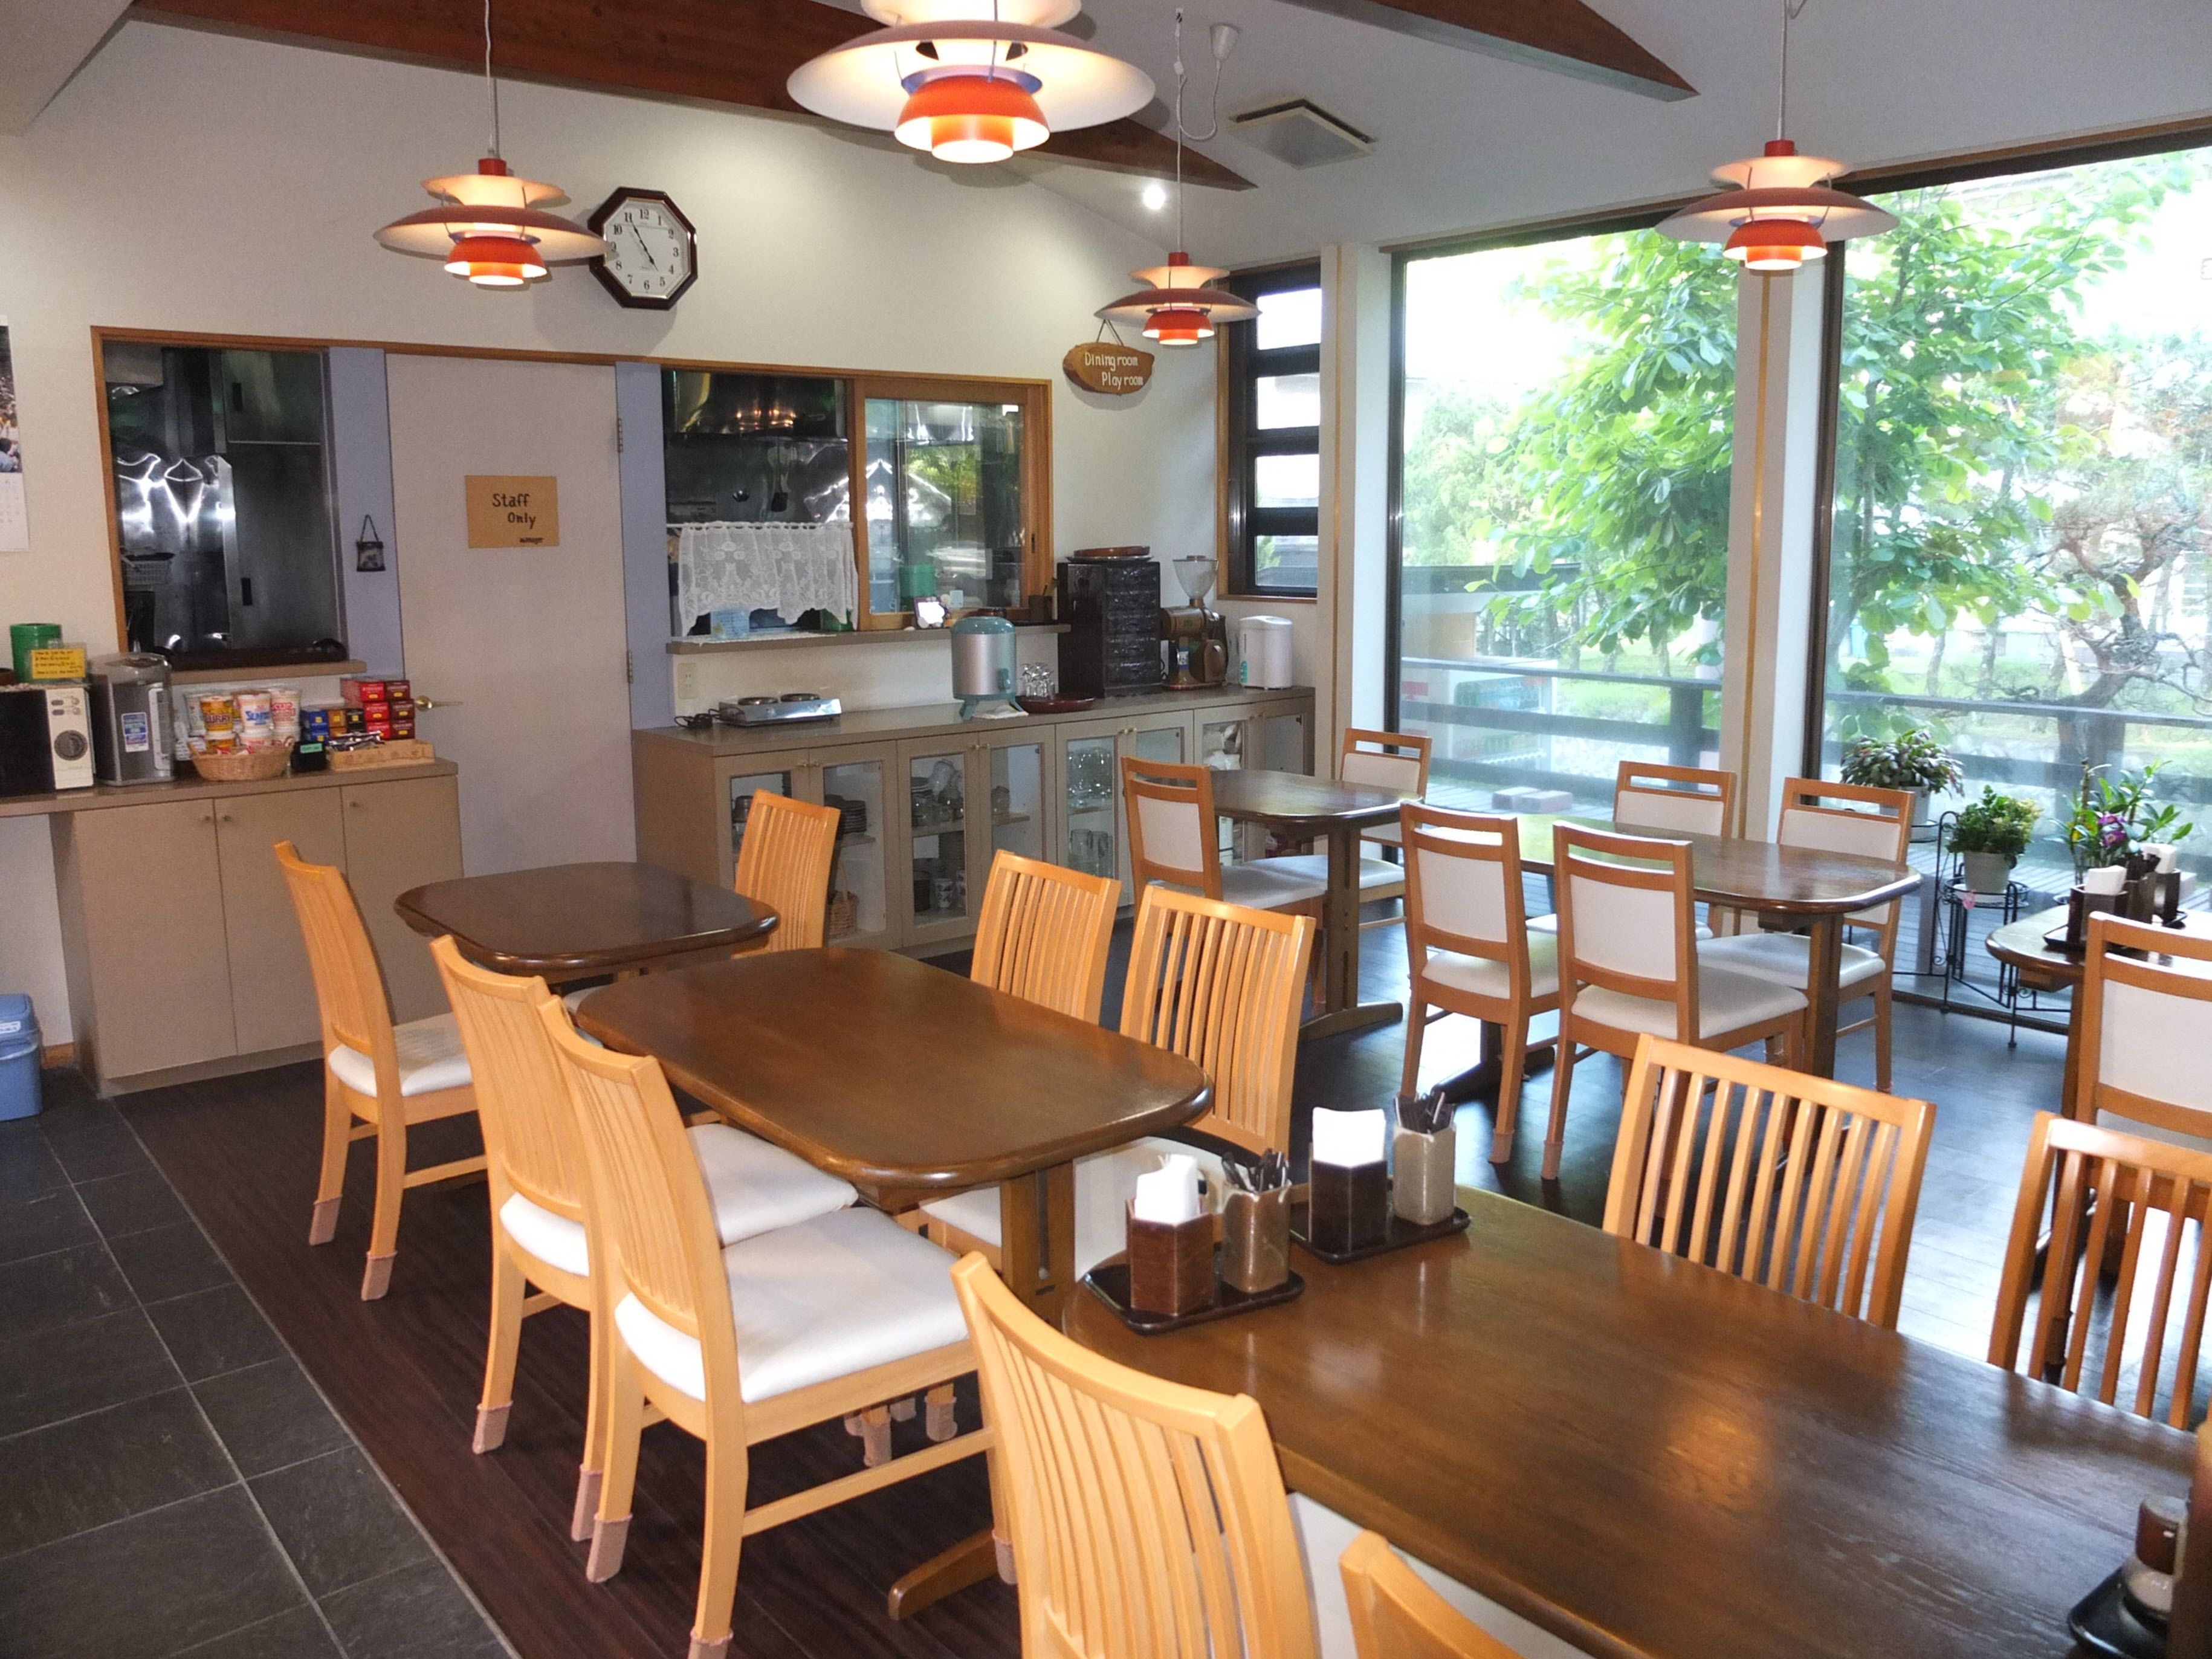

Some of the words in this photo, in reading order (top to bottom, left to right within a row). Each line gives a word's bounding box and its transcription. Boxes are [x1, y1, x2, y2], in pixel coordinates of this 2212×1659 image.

[624, 212, 633, 222] 11
[639, 209, 650, 220] 12
[658, 216, 662, 225] 1
[613, 224, 623, 234] 10
[668, 229, 674, 239] 2
[610, 242, 617, 252] 9
[673, 247, 679, 257] 3
[615, 260, 623, 271] 8
[668, 264, 674, 275] 4
[627, 274, 634, 285] 7
[659, 276, 666, 287] 5
[644, 280, 650, 291] 6
[1084, 352, 1116, 372] Dining
[1117, 356, 1139, 367] room
[1101, 371, 1122, 390] Play
[1124, 376, 1144, 386] room
[492, 493, 531, 508] Staff
[507, 511, 536, 529] Only
